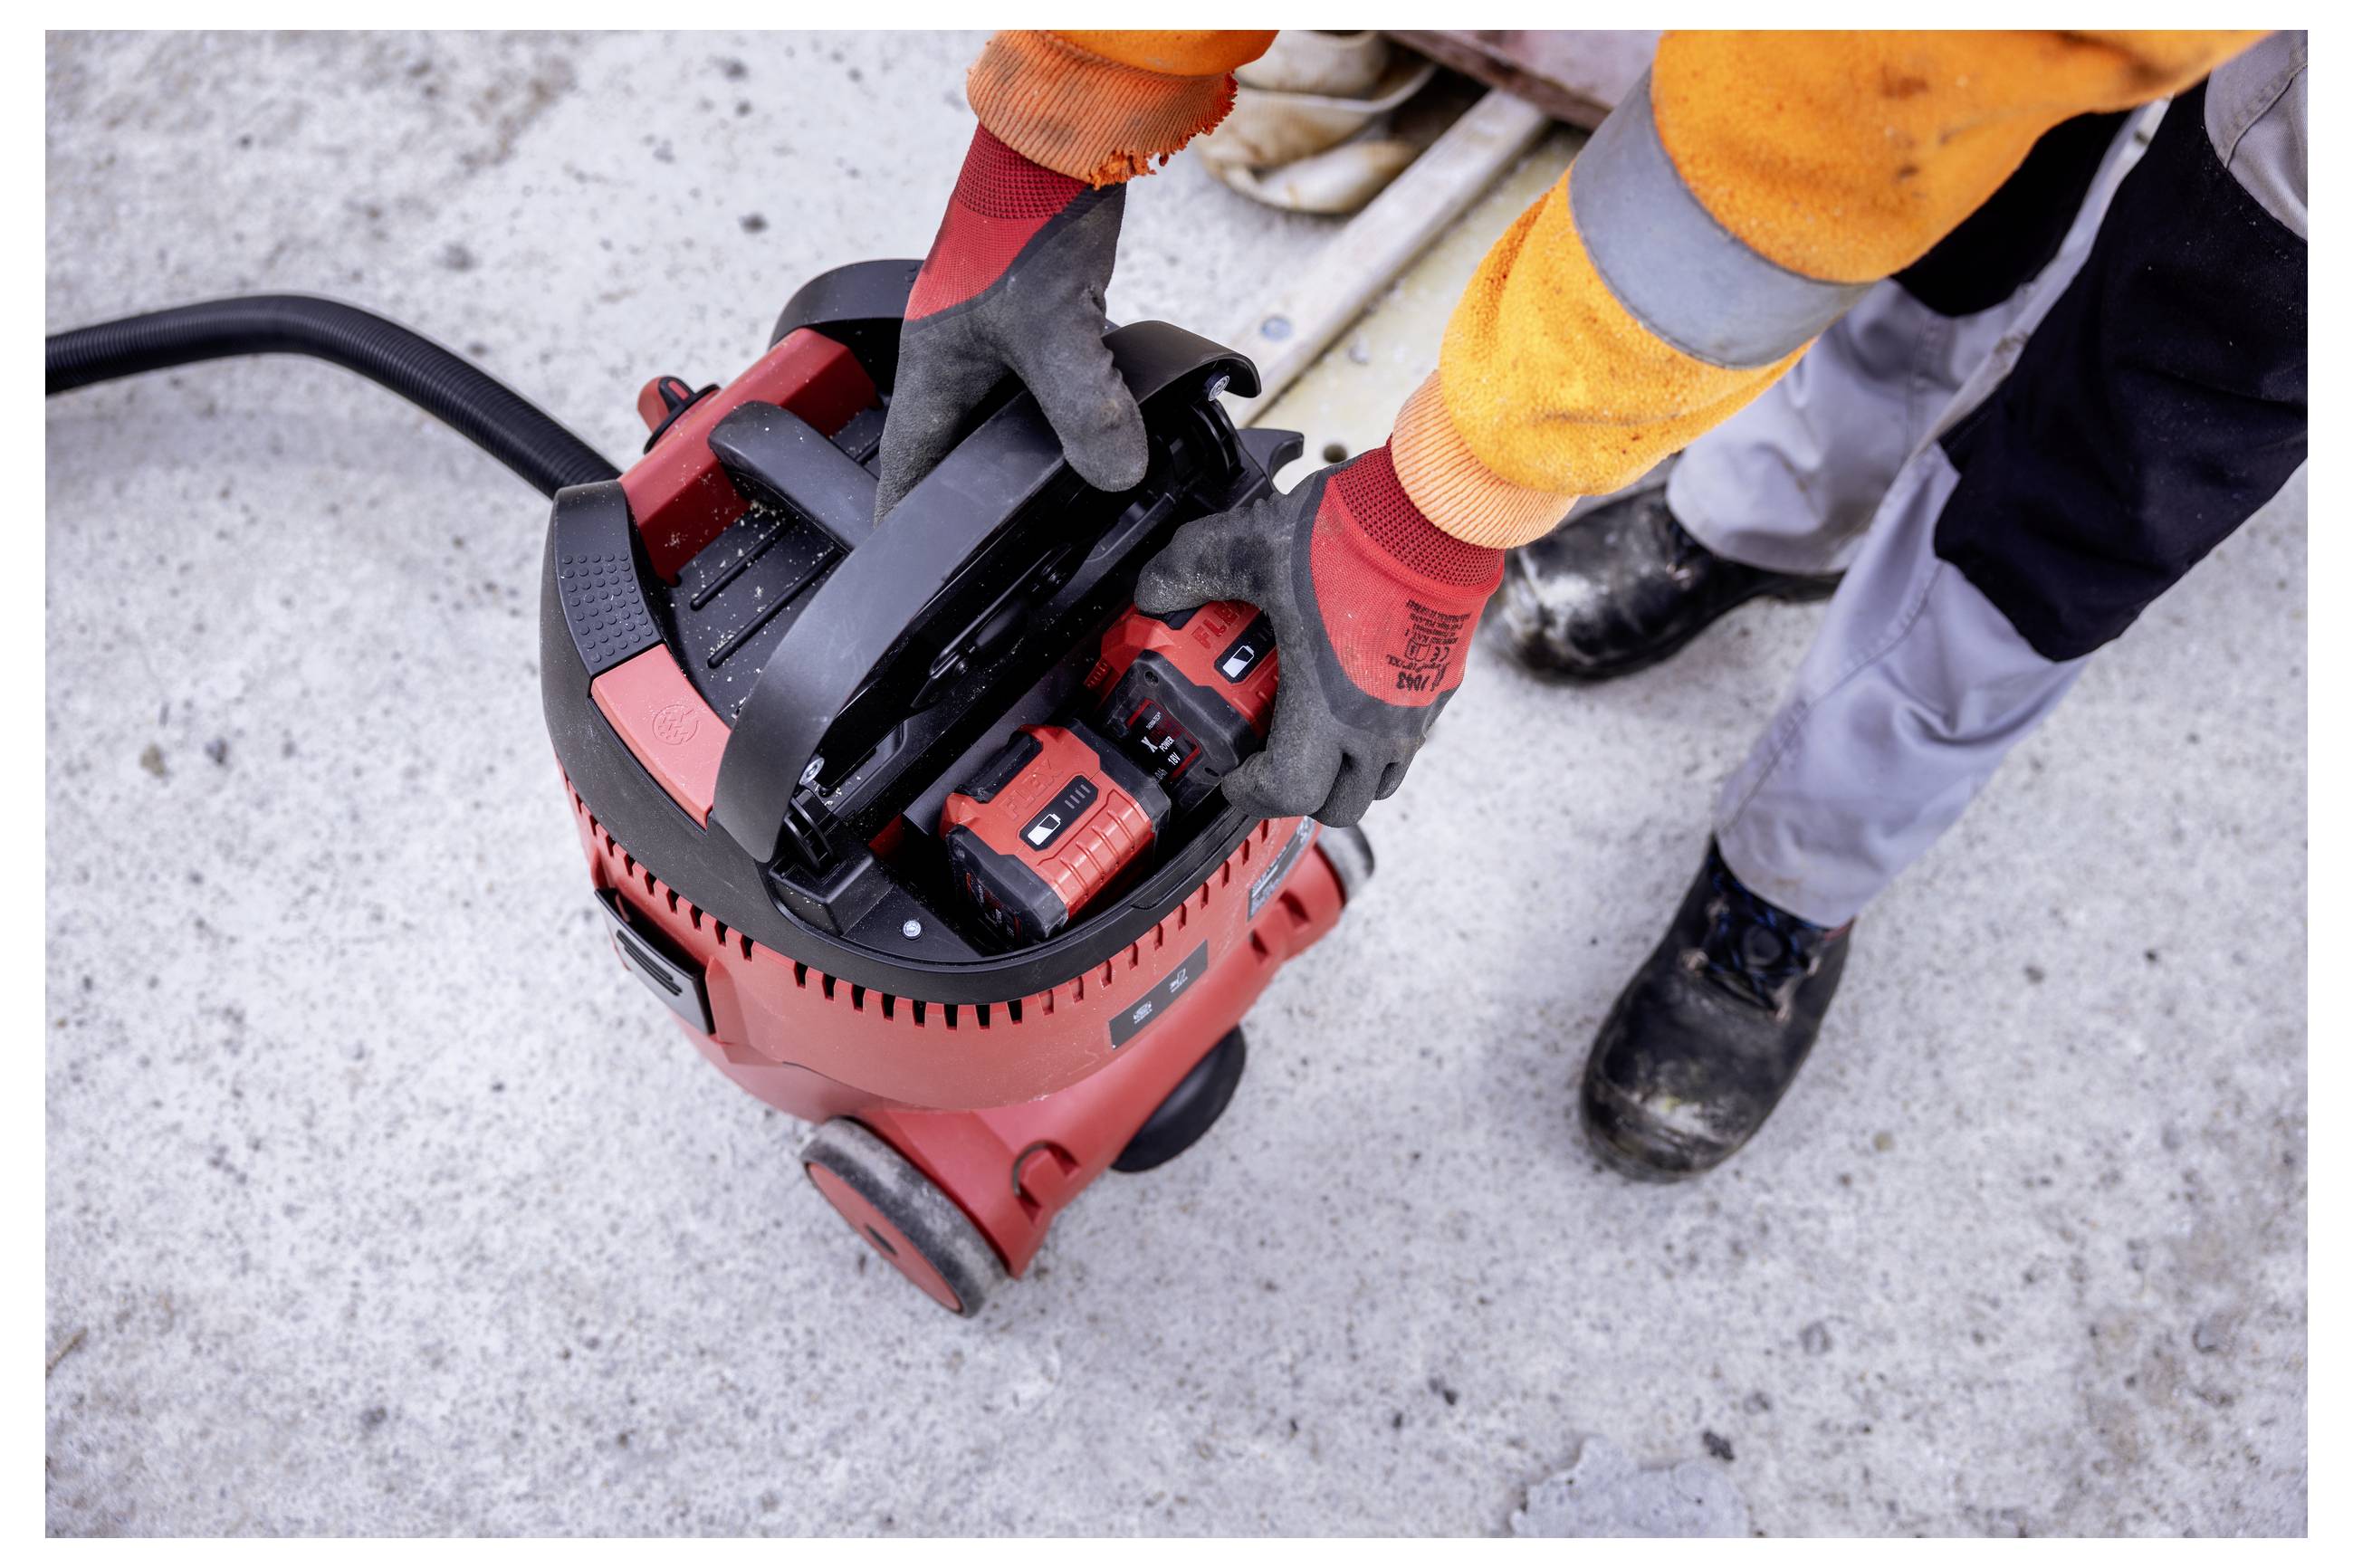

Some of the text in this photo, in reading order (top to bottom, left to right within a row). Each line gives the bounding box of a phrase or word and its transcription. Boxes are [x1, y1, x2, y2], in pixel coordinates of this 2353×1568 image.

[1159, 735, 1175, 752] POWER
[1167, 751, 1181, 766] 18V
[997, 759, 1064, 822] FLEX
